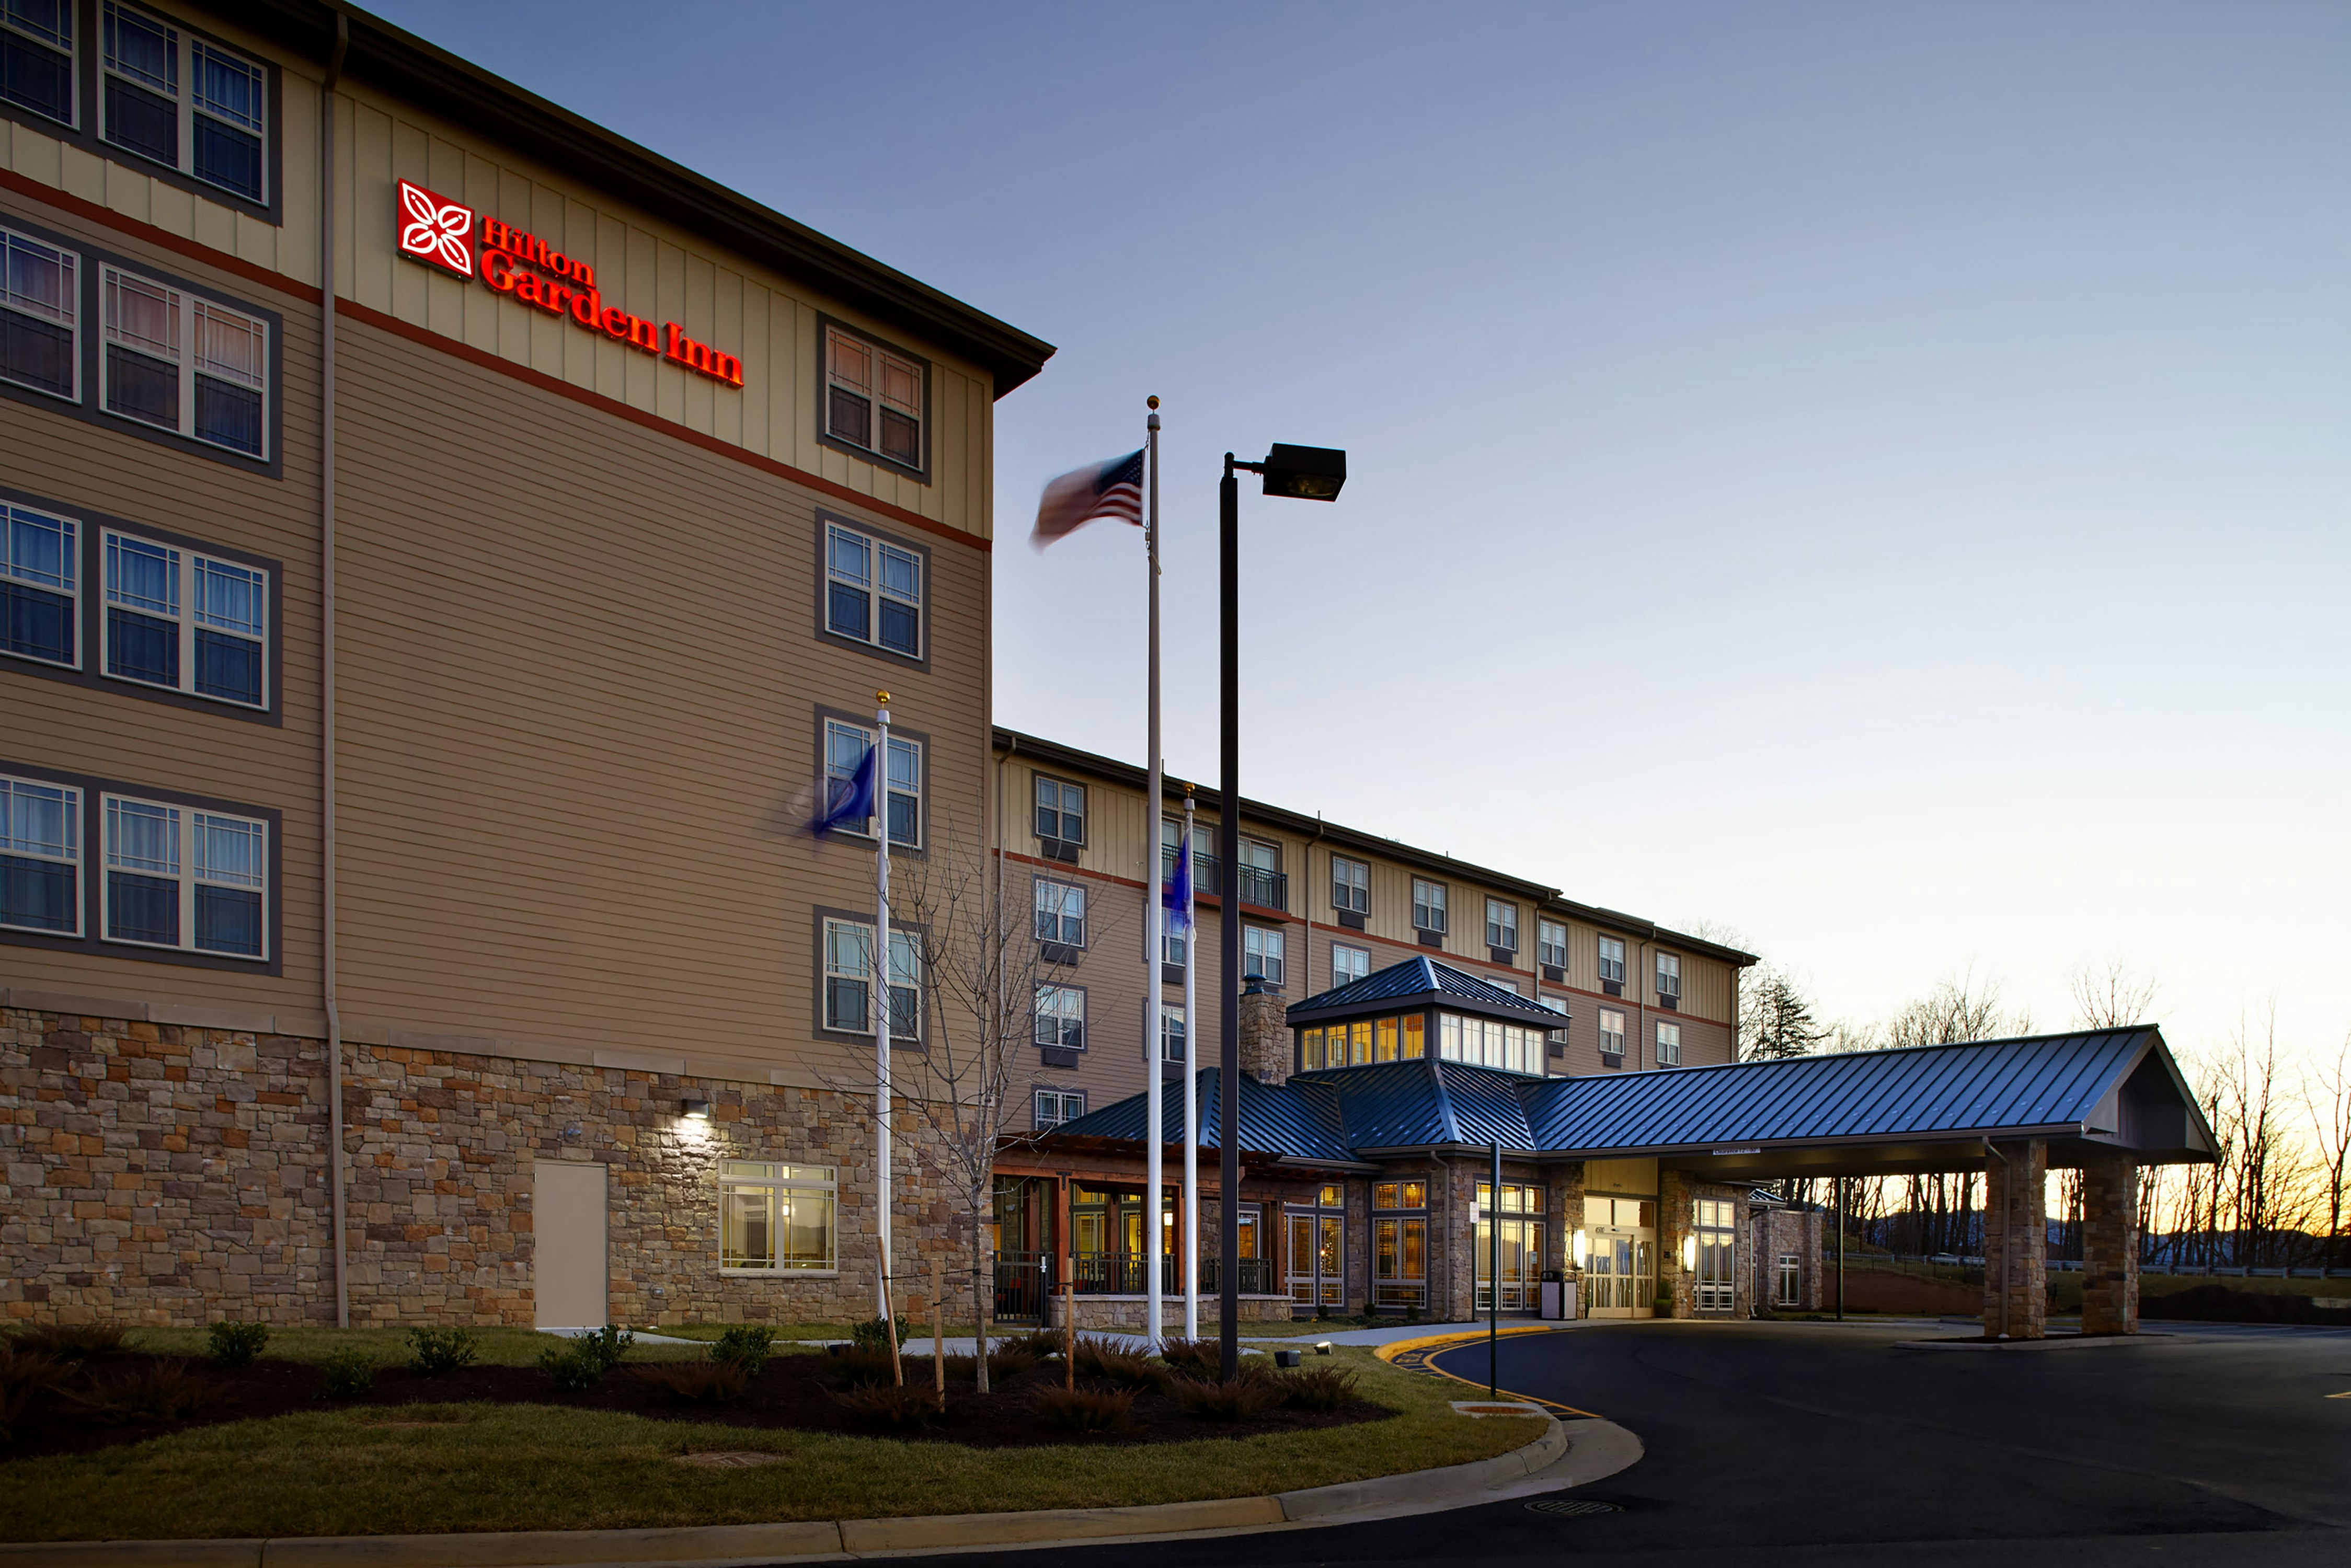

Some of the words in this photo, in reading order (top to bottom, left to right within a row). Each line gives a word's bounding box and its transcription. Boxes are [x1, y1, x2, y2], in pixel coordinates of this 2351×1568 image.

[481, 215, 597, 290] Hilton
[480, 248, 660, 355] Garden
[663, 320, 744, 389] Inn
